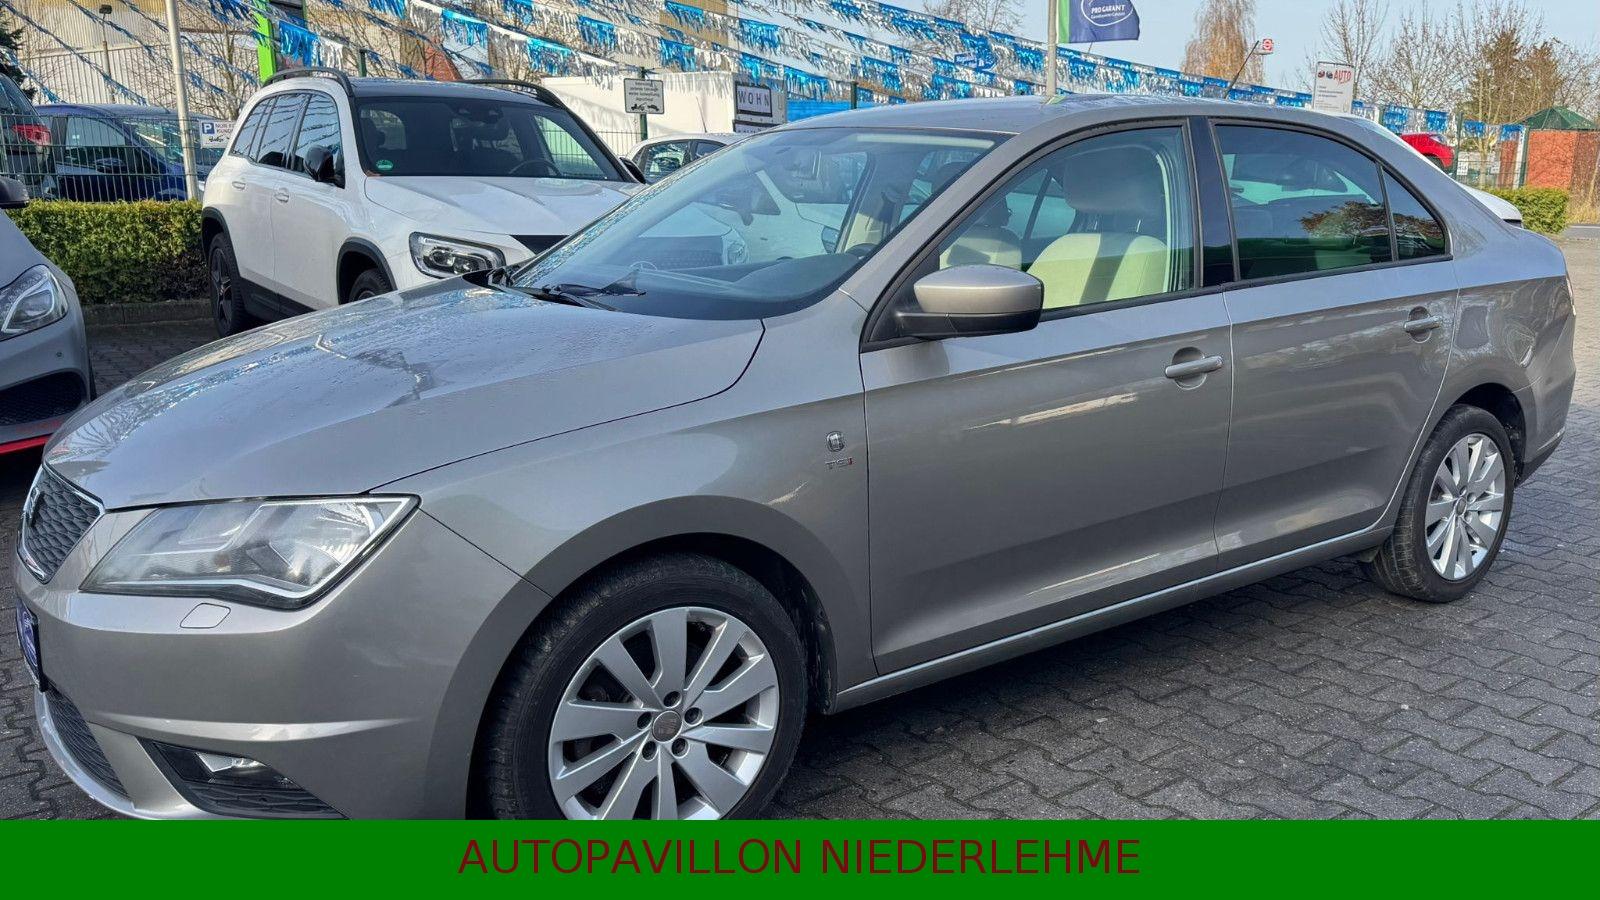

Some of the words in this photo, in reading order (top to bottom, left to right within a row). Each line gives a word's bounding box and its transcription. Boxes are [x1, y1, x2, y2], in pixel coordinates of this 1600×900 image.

[1091, 6, 1102, 14] PRO
[1333, 70, 1352, 81] AUTO
[737, 90, 770, 107] WOHN
[825, 456, 853, 470] TSI
